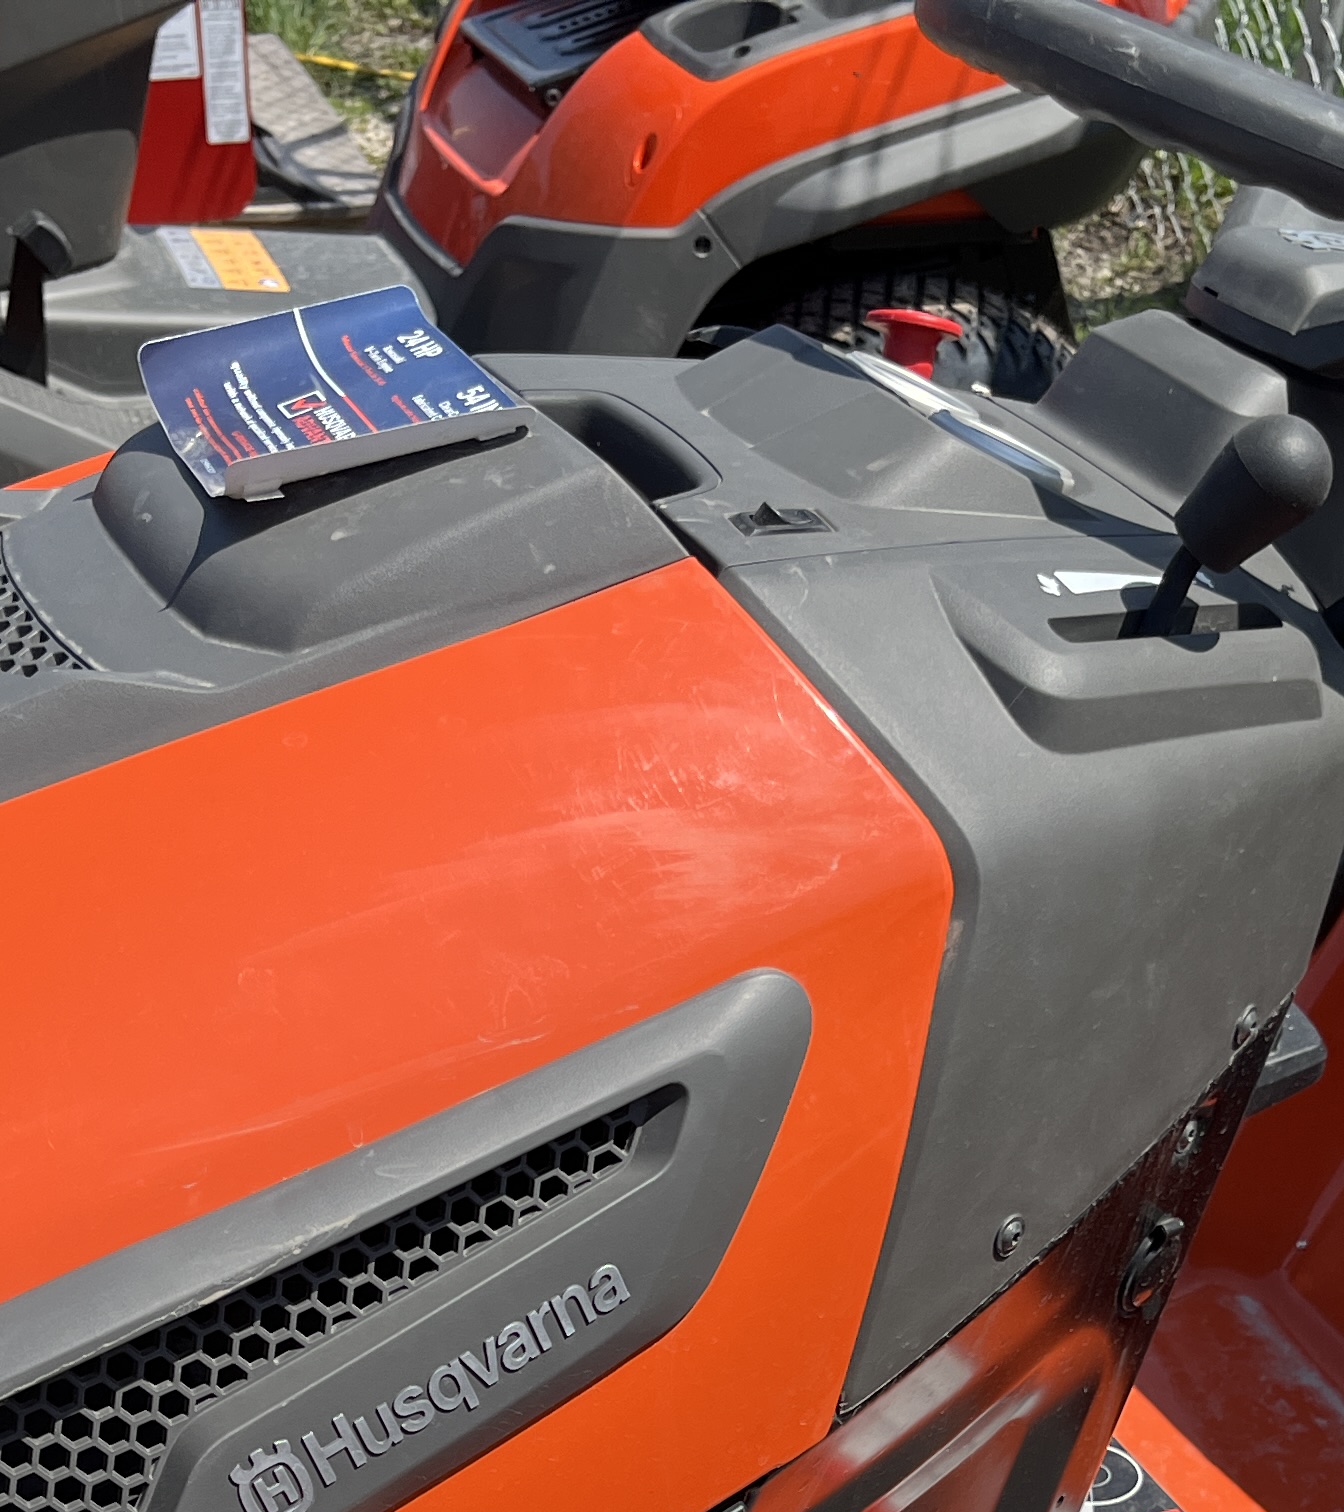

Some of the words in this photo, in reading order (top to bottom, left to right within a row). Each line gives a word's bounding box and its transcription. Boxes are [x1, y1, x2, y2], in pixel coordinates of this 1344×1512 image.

[396, 329, 430, 349] 24
[409, 340, 443, 359] HP
[456, 385, 490, 406] 54
[301, 1263, 631, 1486] Husqvarna
